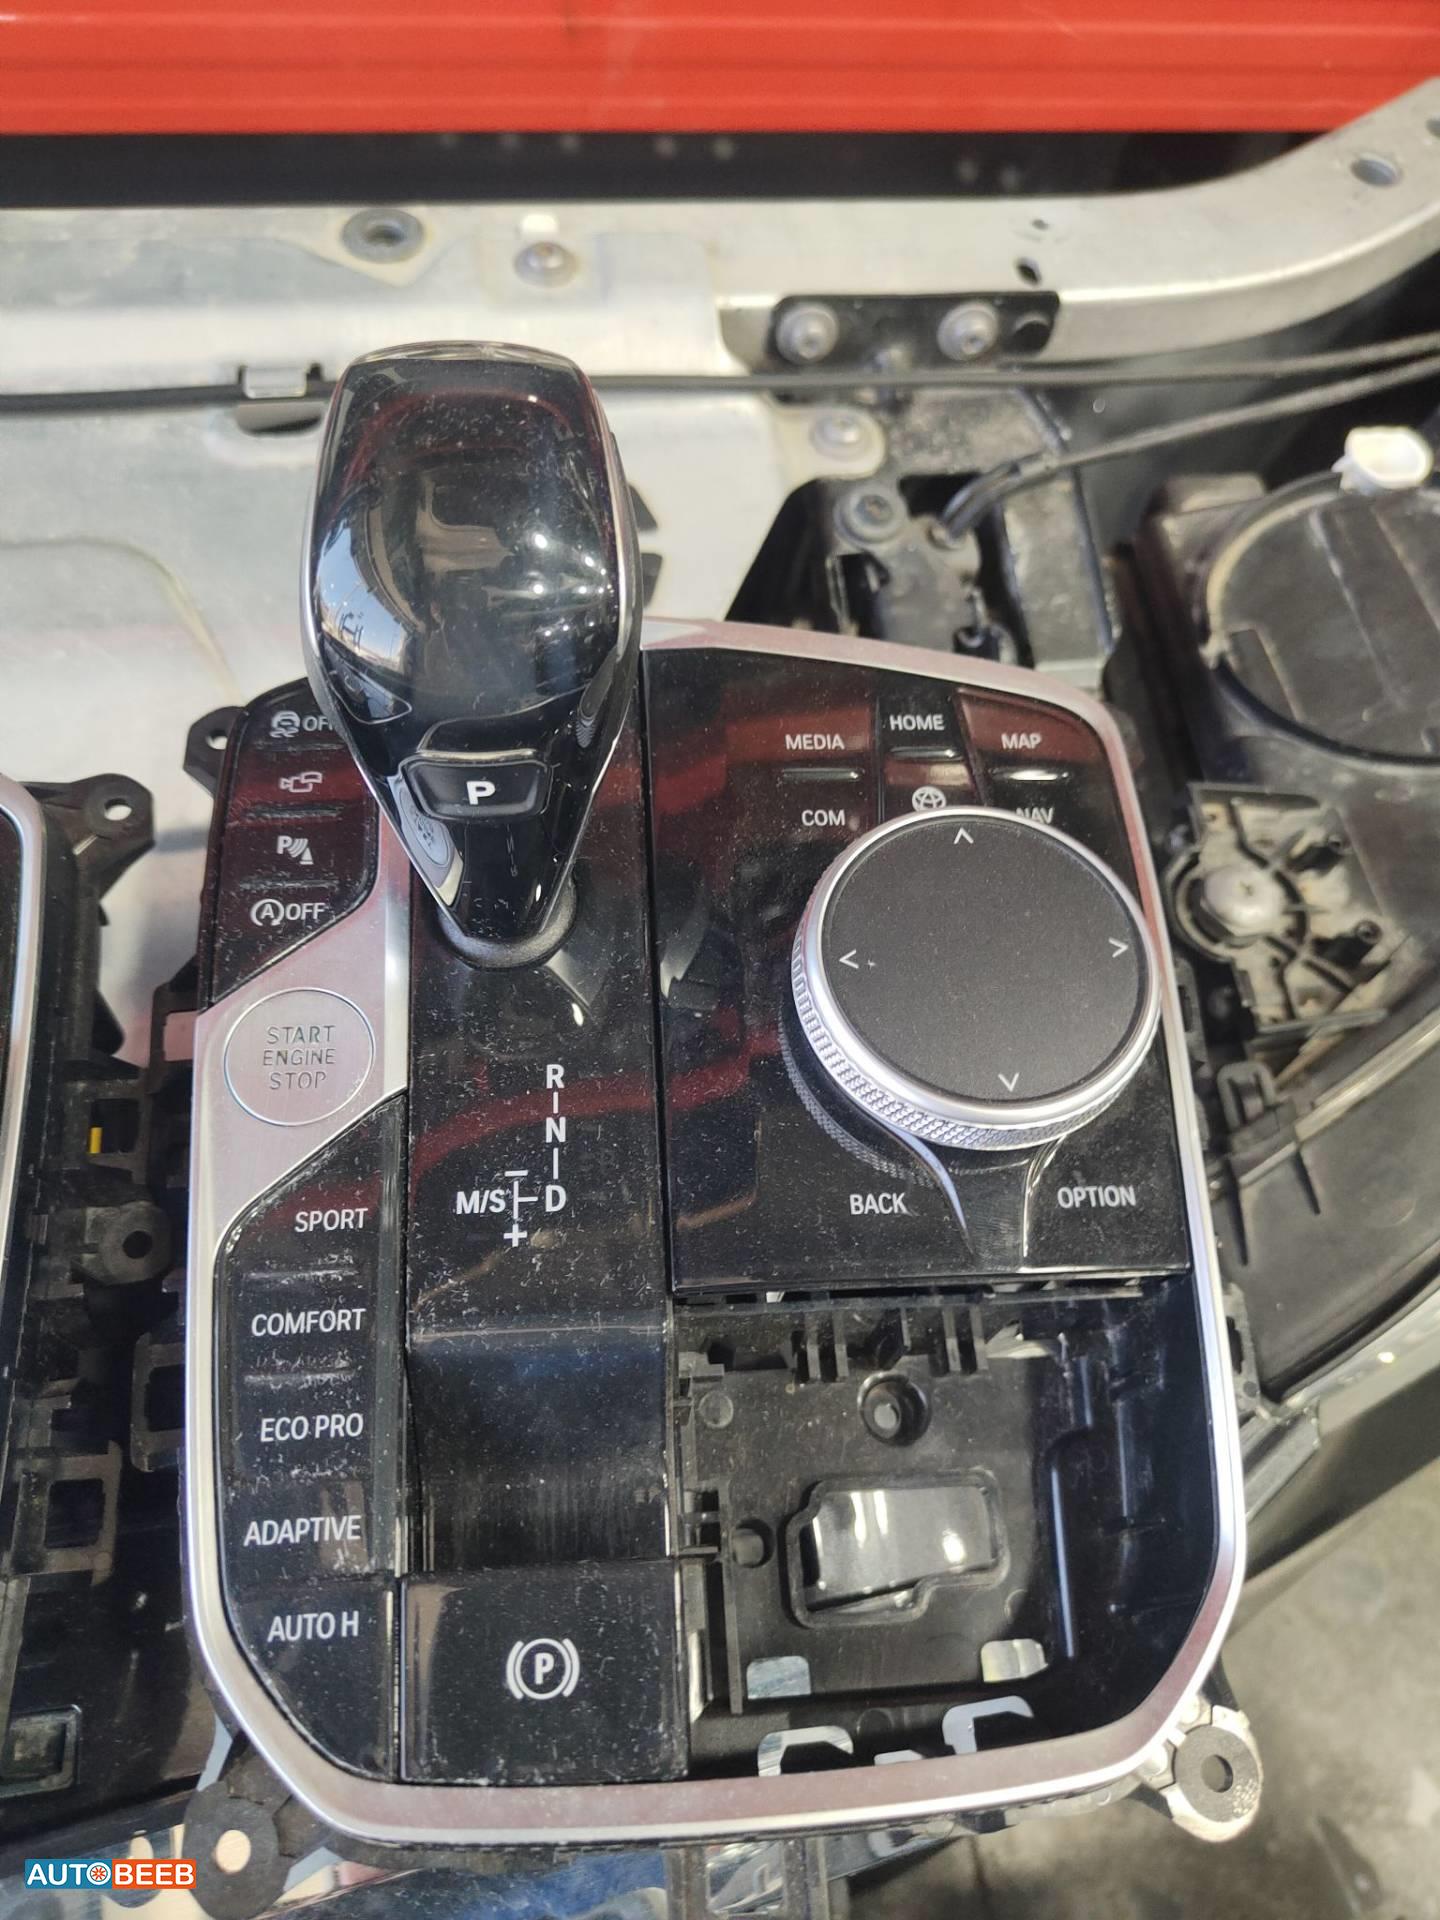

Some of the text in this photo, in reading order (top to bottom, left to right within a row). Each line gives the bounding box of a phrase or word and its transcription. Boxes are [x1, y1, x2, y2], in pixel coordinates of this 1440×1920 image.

[889, 714, 945, 731] HOME
[785, 734, 845, 751] MEDIA
[1001, 733, 1042, 750] MAP
[466, 780, 496, 805] P
[801, 809, 846, 827] COM
[285, 902, 326, 921] OFF
[266, 1025, 336, 1045] START
[263, 1048, 336, 1066] ENGINE
[269, 1071, 327, 1090] STOP
[546, 1063, 565, 1089] R
[545, 1116, 567, 1143] N
[456, 1184, 567, 1215] M/S D
[849, 1192, 908, 1215] BACK
[1057, 1185, 1137, 1209] OPTION
[294, 1208, 369, 1233] SPORT
[251, 1308, 367, 1336] COMFORT
[260, 1413, 364, 1442] ECO PRO
[243, 1515, 362, 1547] ADAPTIVE
[267, 1611, 360, 1643] AUTO H
